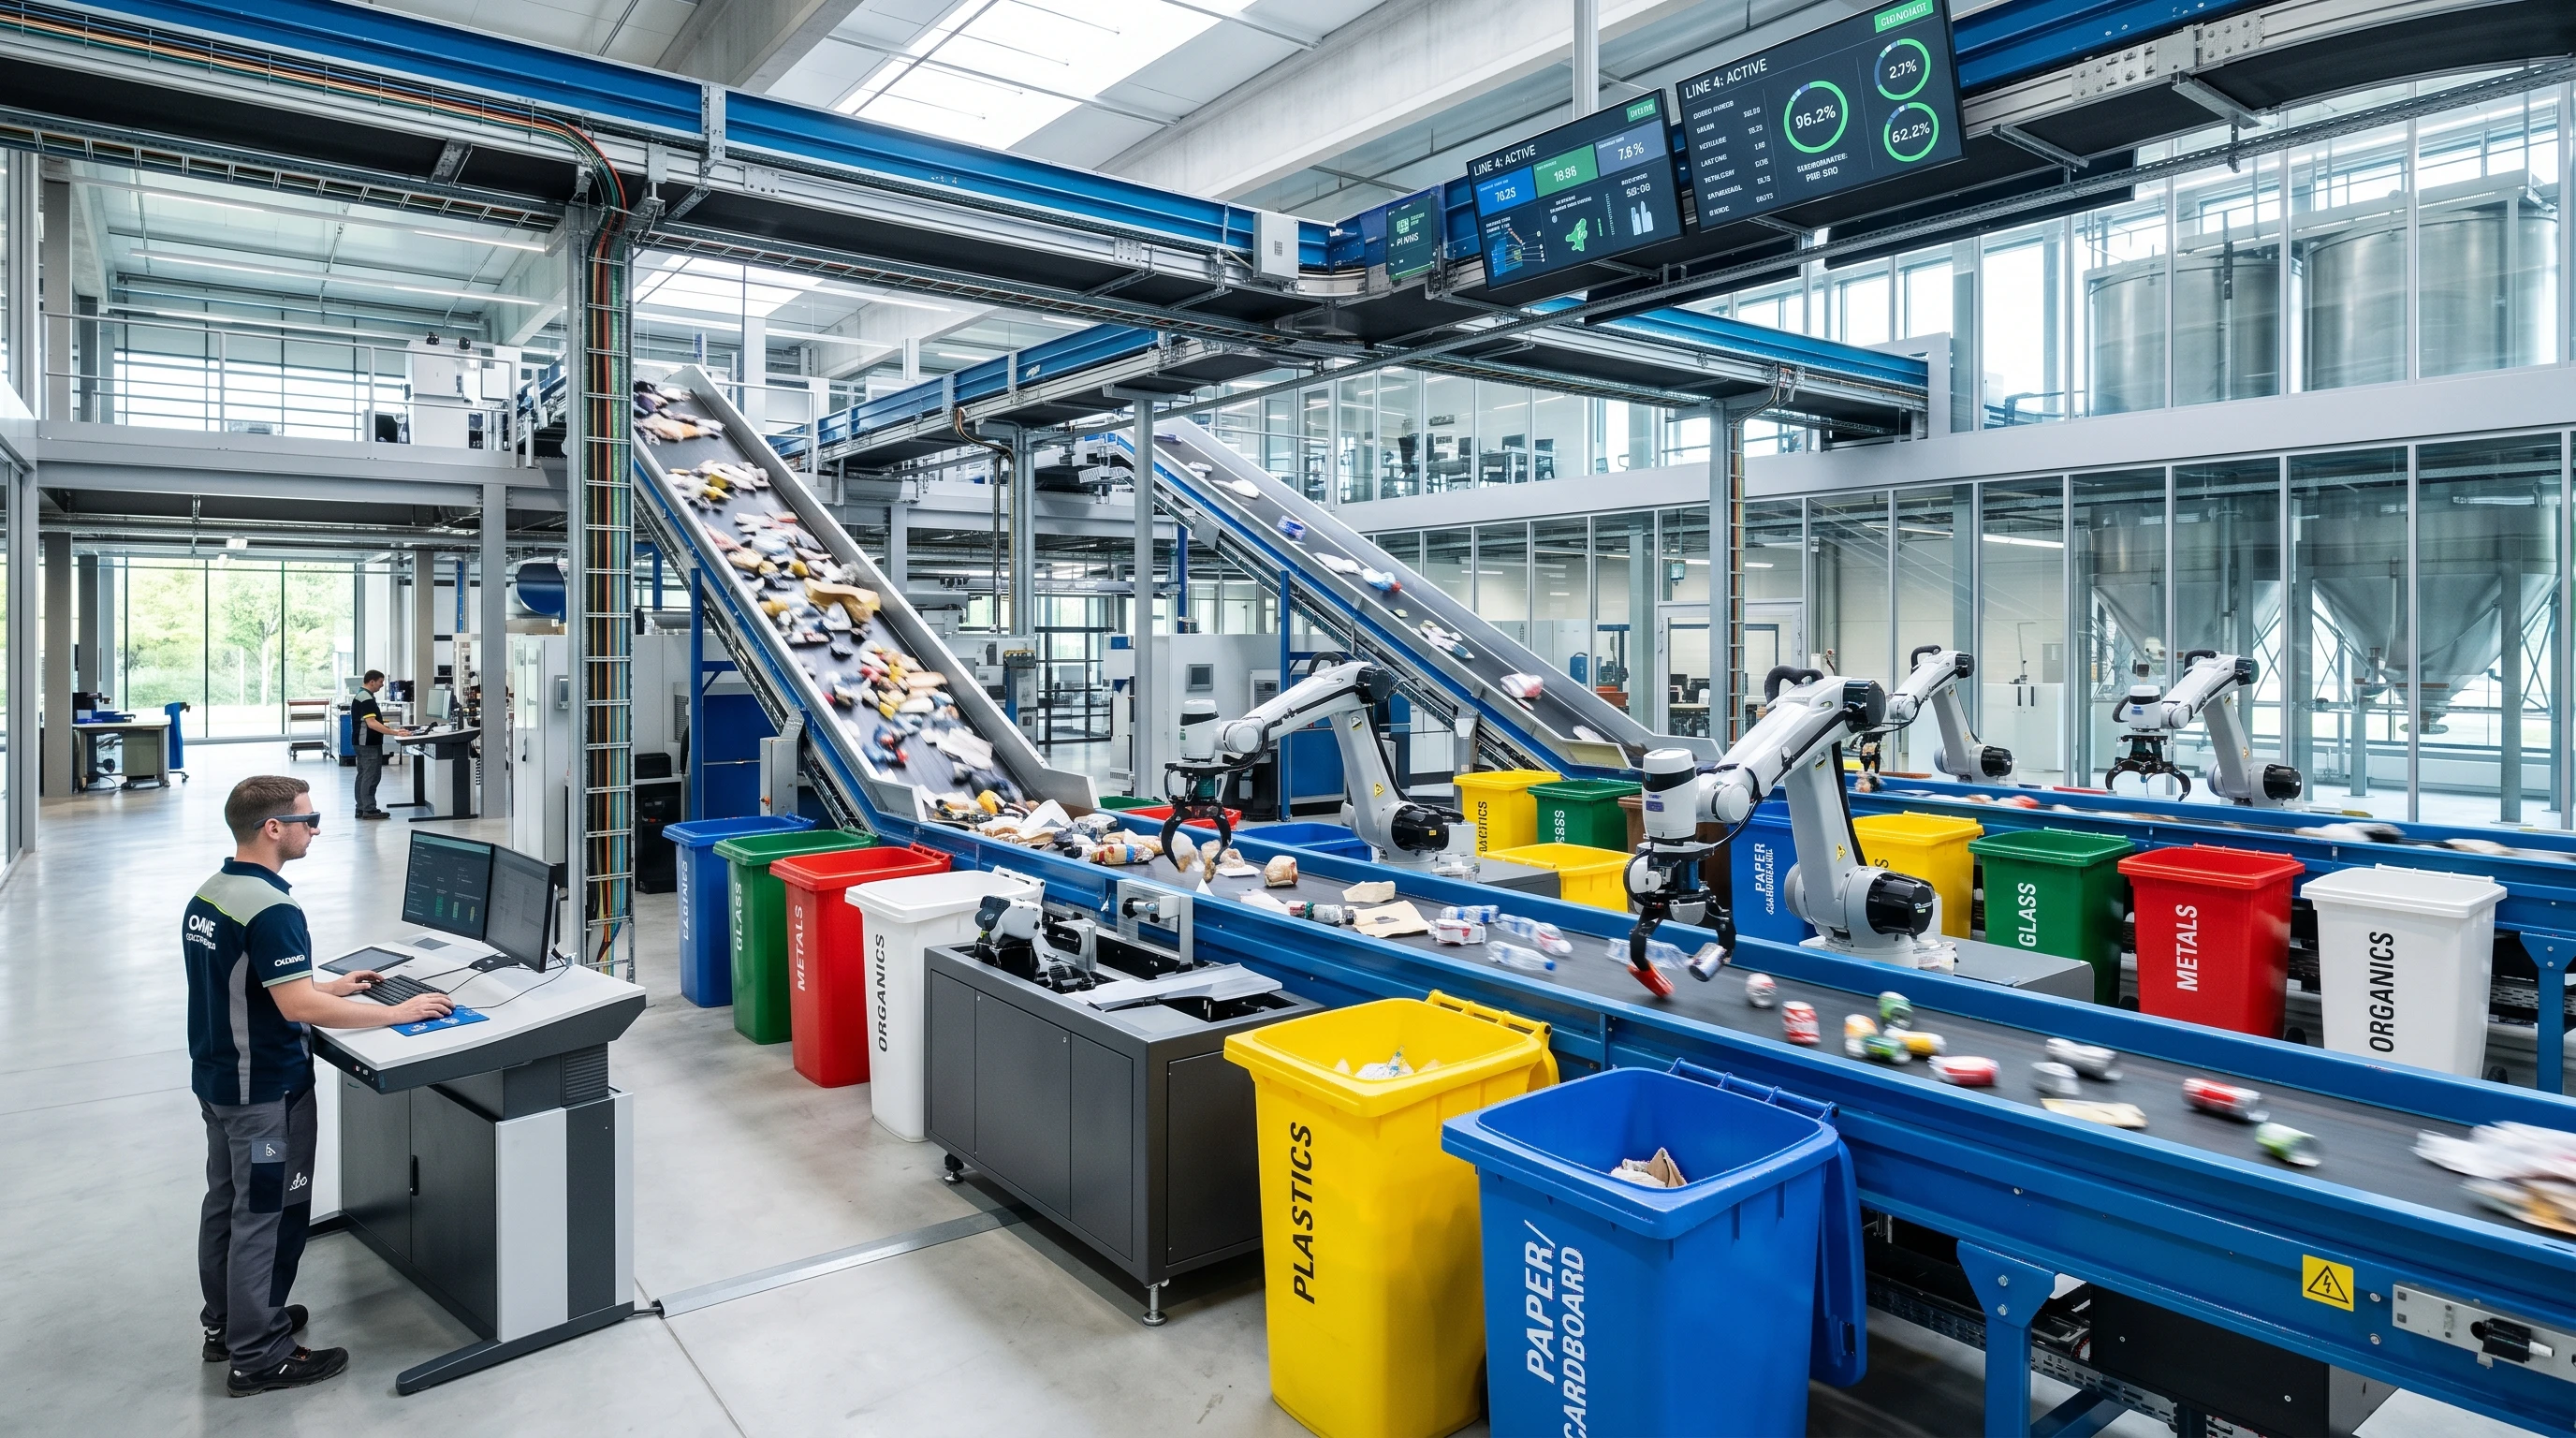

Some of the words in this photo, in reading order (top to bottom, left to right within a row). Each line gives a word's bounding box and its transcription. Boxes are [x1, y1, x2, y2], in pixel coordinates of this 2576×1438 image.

[1685, 77, 1712, 99] LINE
[1713, 73, 1724, 89] 4:
[1726, 58, 1768, 84] ACTIVE
[1889, 59, 1917, 80] 2.7%
[1795, 104, 1837, 129] 96.2%
[1892, 122, 1930, 143] 62.2%
[1474, 160, 1493, 176] LINE
[1495, 157, 1503, 169] 4:
[1505, 144, 1536, 165] ACTIVE
[1754, 843, 1765, 892] PAPER
[735, 882, 743, 951] GLASS
[795, 904, 806, 991] METALS
[2018, 882, 2037, 947] GLASS
[2174, 904, 2198, 992] METALS
[876, 933, 888, 1053] ORGANICS
[2368, 932, 2394, 1053] ORGANICS
[1291, 1122, 1315, 1305] PLASTICS
[1524, 1220, 1556, 1385] PAPER/
[1561, 1246, 1587, 1438] CARDBOARD
